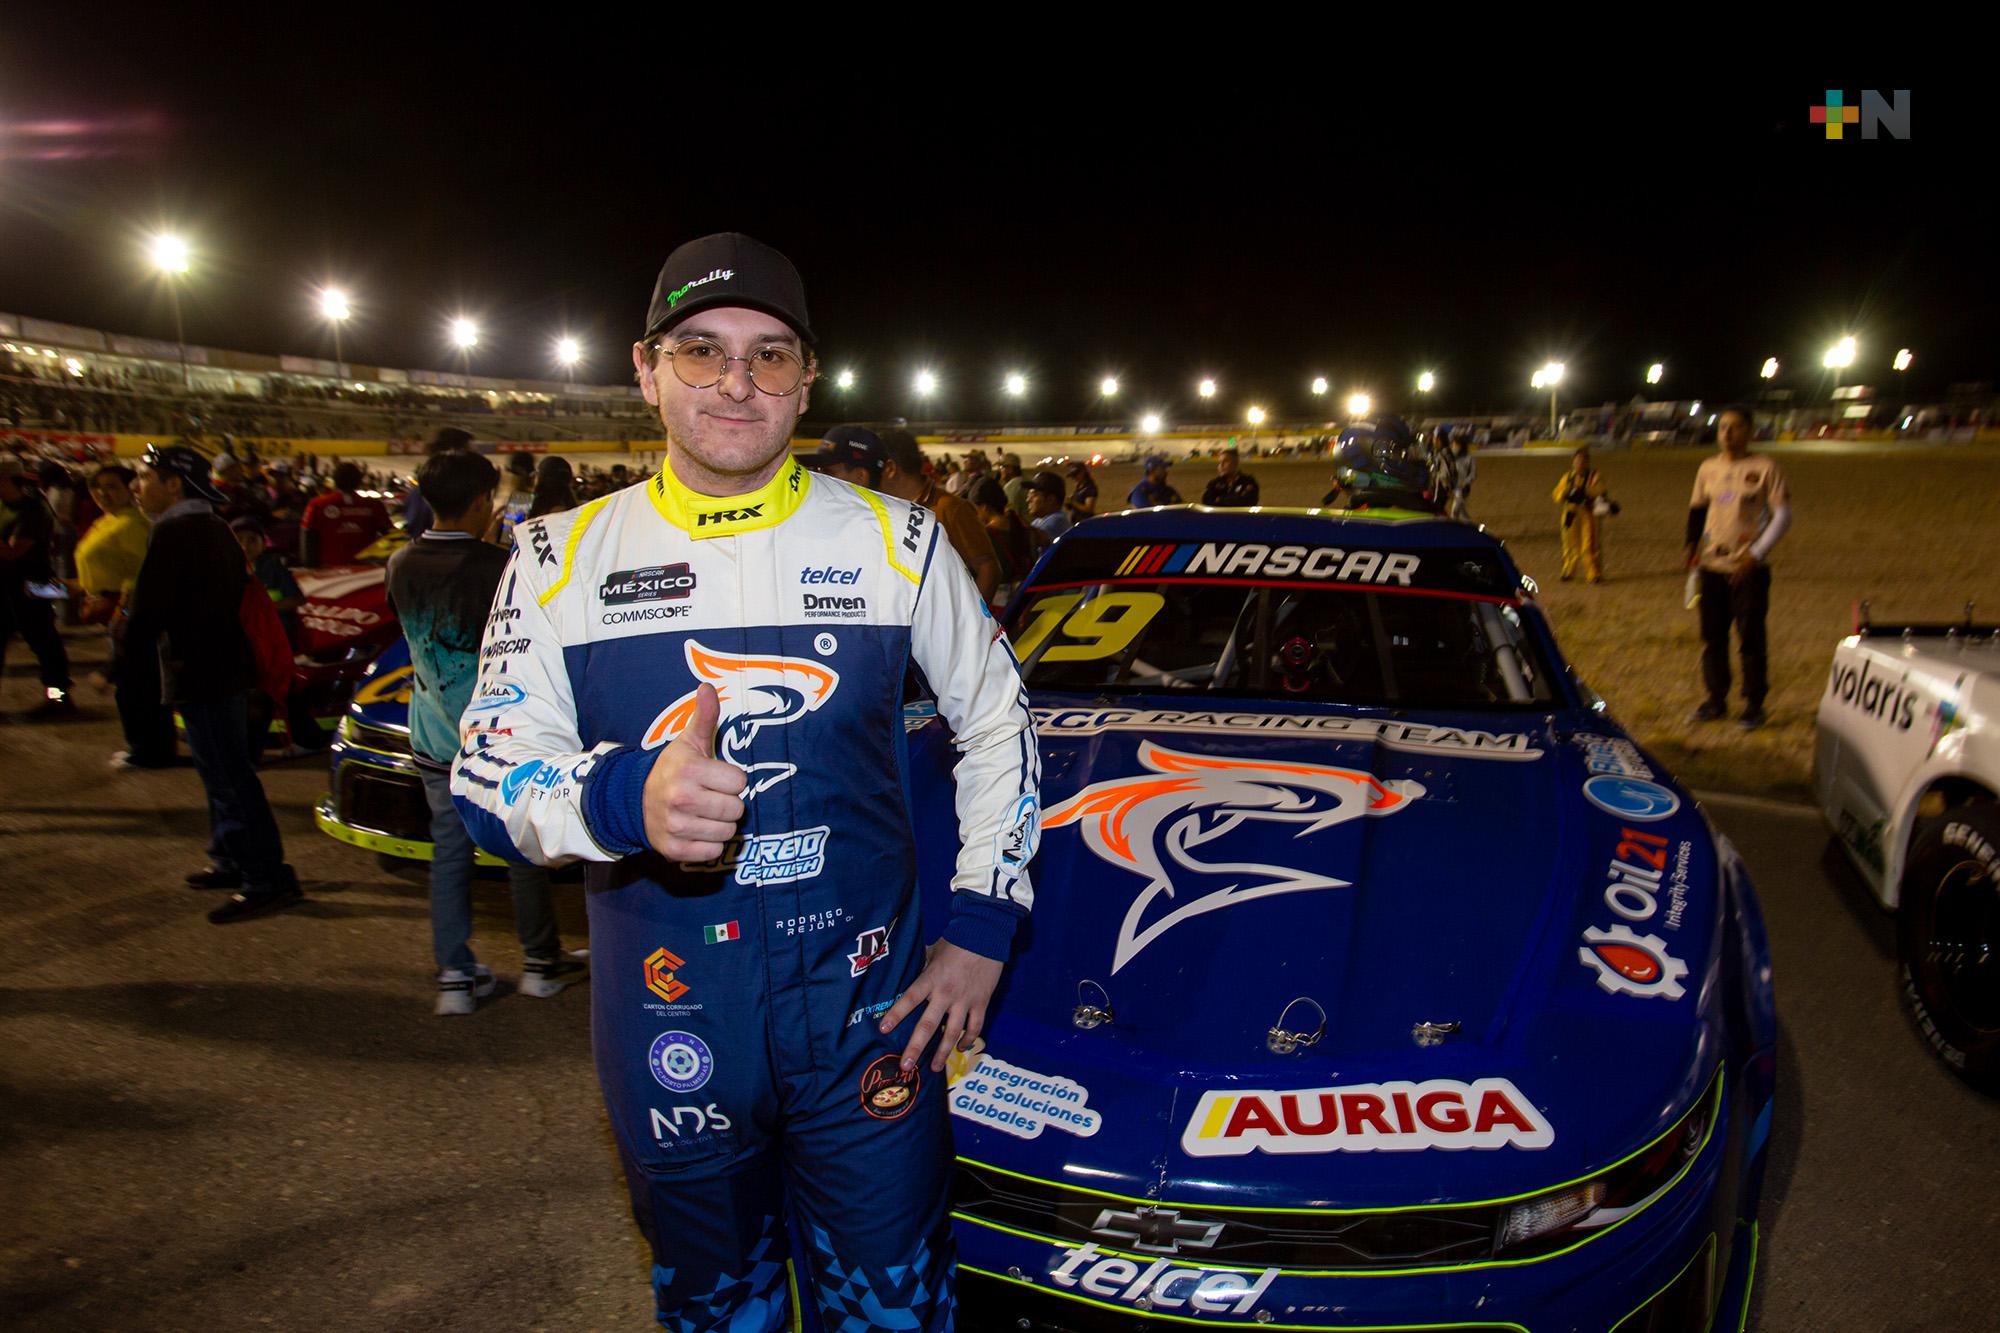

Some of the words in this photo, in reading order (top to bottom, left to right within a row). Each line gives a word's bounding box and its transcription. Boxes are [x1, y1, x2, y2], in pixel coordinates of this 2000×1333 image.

[667, 268, 735, 308] Prorally
[697, 502, 765, 526] HRX
[527, 518, 558, 568] HRX
[639, 569, 665, 578] NASCAR
[800, 566, 863, 585] telcel
[1185, 543, 1421, 587] NASCAR
[602, 576, 694, 597] MÉXICO
[803, 593, 866, 610] Driven
[602, 607, 690, 625] COMMSCOPE
[1017, 592, 1165, 662] 19
[486, 638, 532, 659] NASCAR
[1832, 658, 1918, 730] volaris
[1149, 711, 1352, 730] RACING
[1371, 719, 1526, 748] TEAM
[700, 831, 825, 867] URBO
[741, 856, 820, 880] FINISH
[776, 908, 843, 928] RODRIGO
[655, 1036, 704, 1055] RACING
[975, 1061, 1080, 1103] Integración
[651, 1103, 731, 1139] NDS
[955, 1095, 1038, 1131] Globales
[965, 1079, 988, 1094] de
[991, 1086, 1094, 1128] Soluciones
[1224, 1090, 1537, 1138] AURIGA
[1049, 1241, 1282, 1315] telcel
